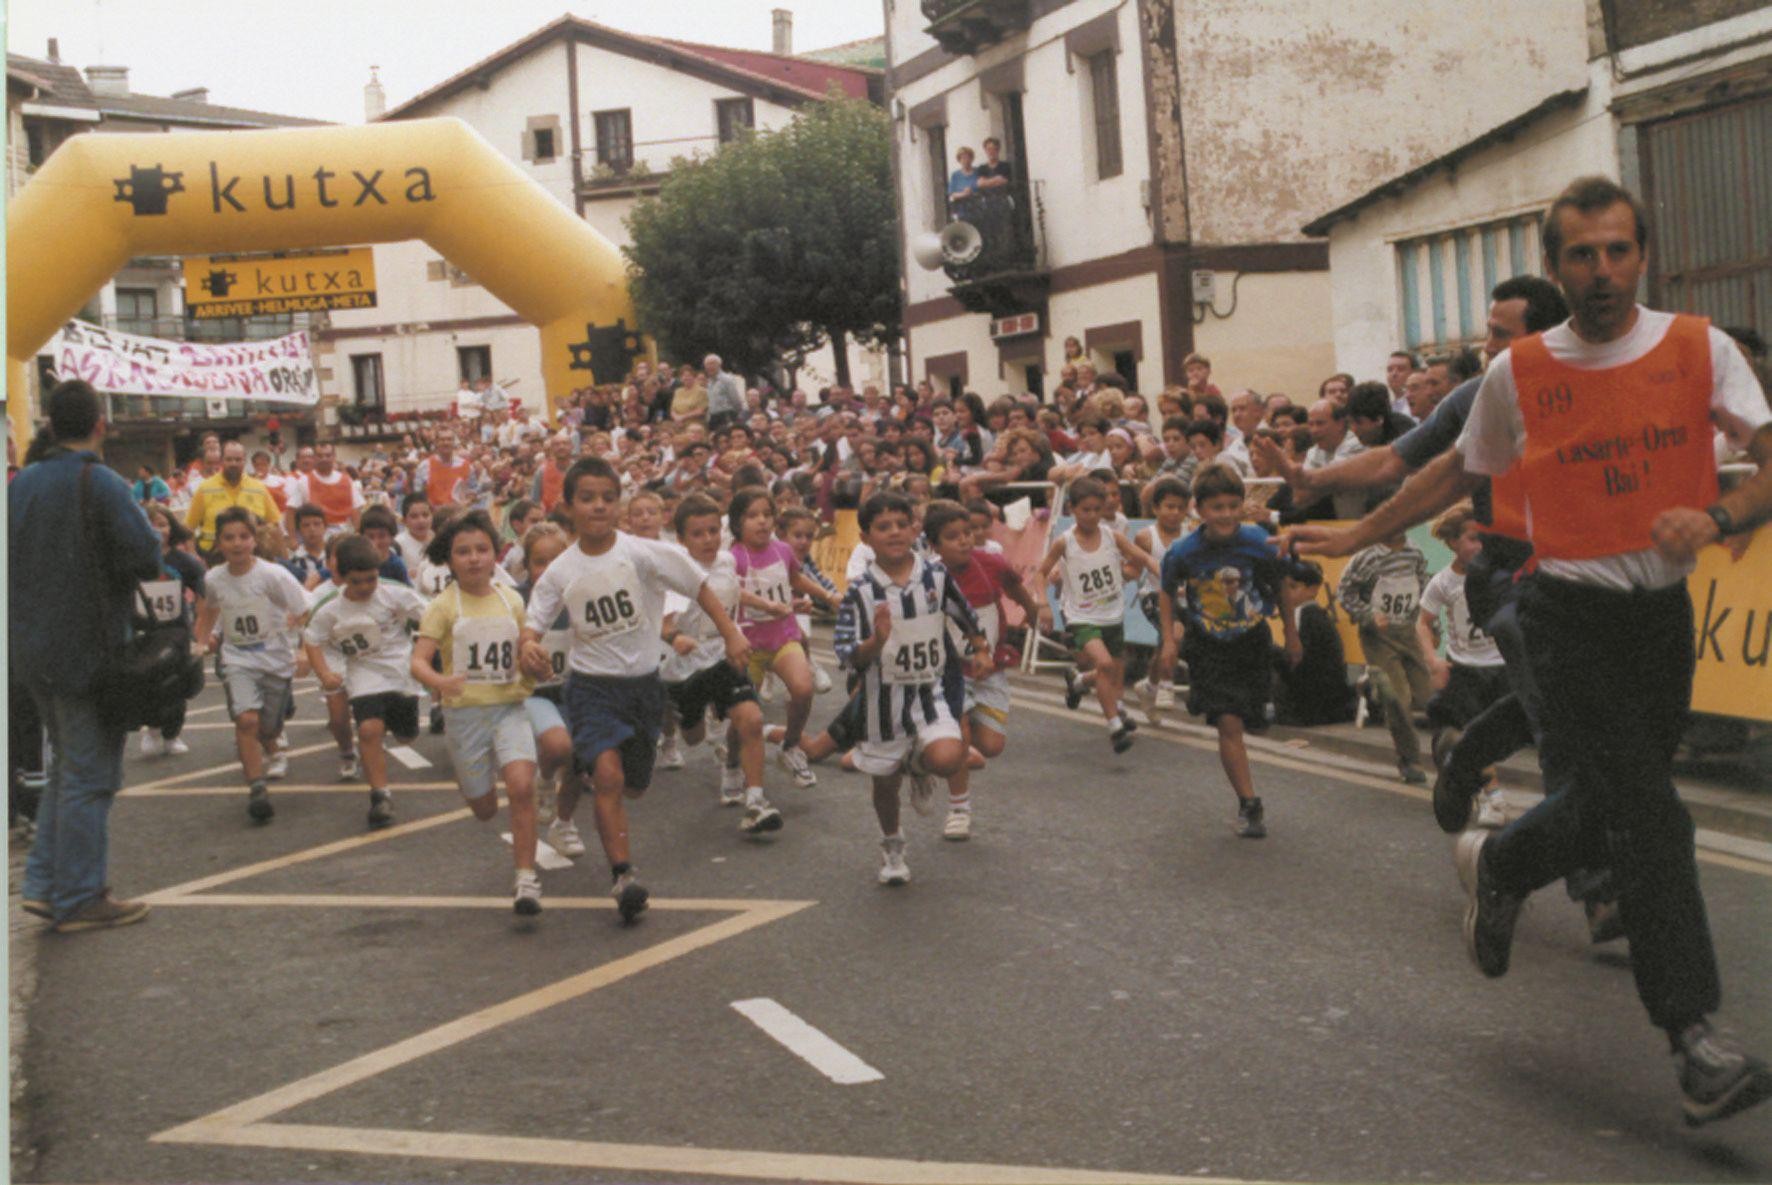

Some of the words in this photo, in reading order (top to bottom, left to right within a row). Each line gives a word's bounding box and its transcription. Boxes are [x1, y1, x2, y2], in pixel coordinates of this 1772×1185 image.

[210, 161, 437, 213] kutxa
[256, 269, 362, 294] kutxa
[1079, 566, 1114, 593] 285
[584, 590, 635, 628] 406
[234, 615, 259, 636] 40
[467, 640, 513, 671] 148
[895, 638, 940, 672] 456
